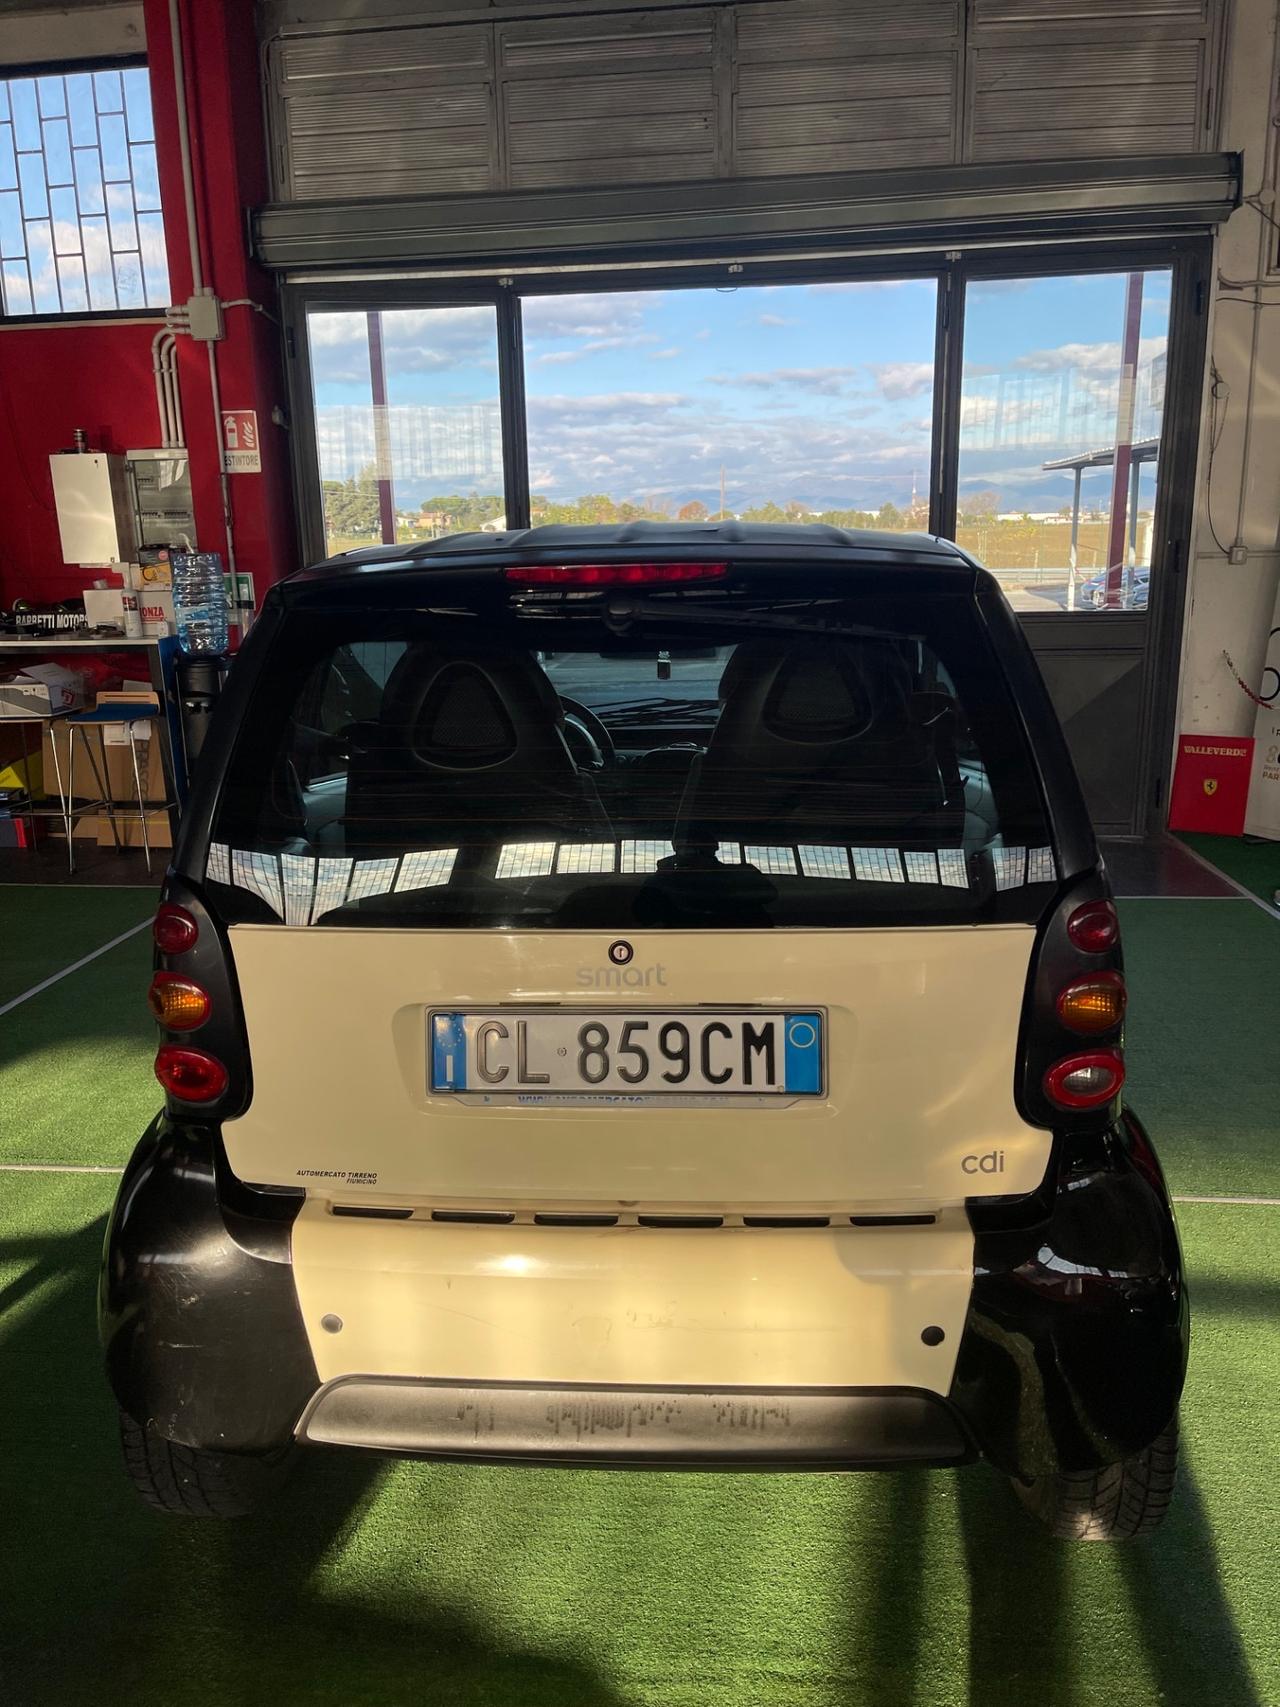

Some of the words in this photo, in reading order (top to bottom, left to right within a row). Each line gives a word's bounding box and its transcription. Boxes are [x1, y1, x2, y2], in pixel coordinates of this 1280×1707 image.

[224, 455, 259, 466] ESTINTORE
[1184, 745, 1247, 757] VALLEVERDE
[1263, 771, 1280, 781] PAR
[576, 963, 667, 987] smart
[476, 1020, 550, 1084] CL
[577, 1020, 776, 1086] 859CM
[961, 1151, 1004, 1174] cdi
[296, 1170, 346, 1178] AUTOMERCATO
